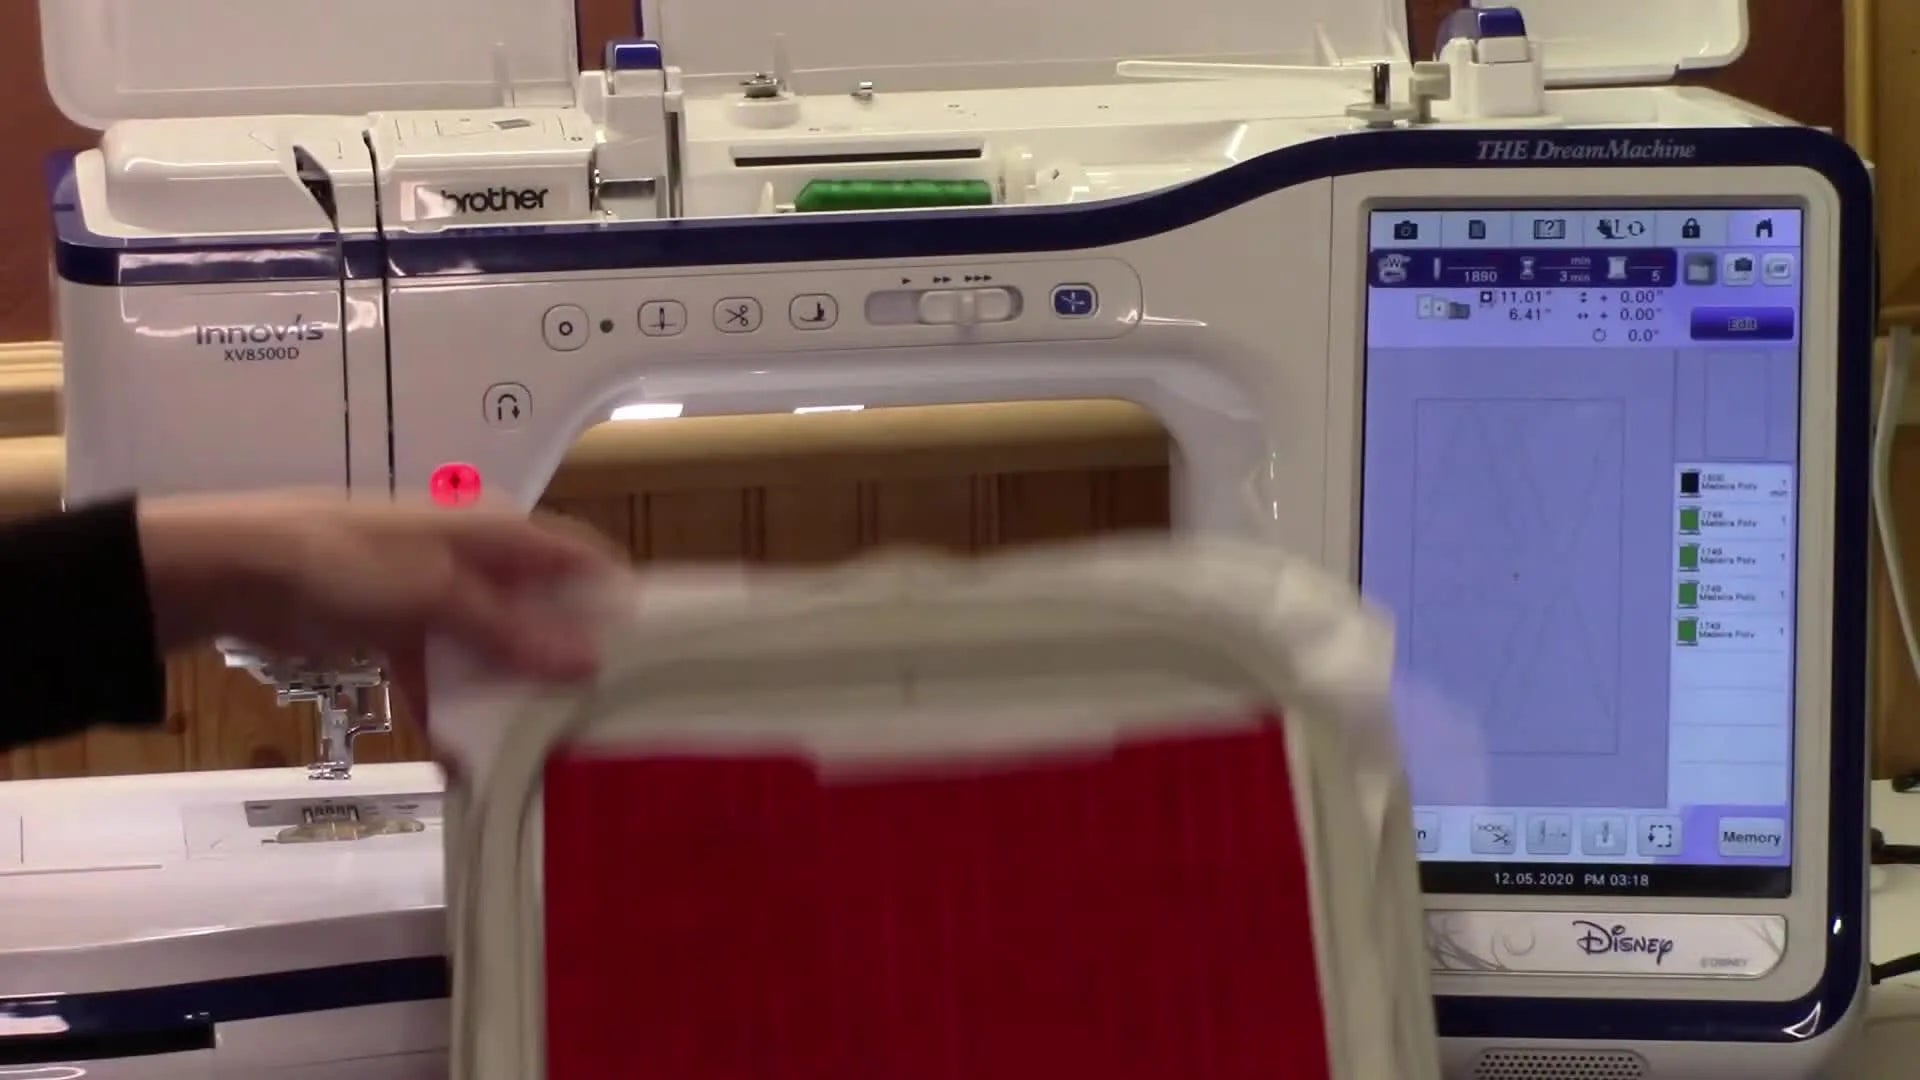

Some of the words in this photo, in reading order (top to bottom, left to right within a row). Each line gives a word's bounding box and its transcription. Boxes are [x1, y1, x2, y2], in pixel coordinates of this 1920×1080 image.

[1477, 139, 1528, 160] THE
[1533, 138, 1696, 160] DreamMachine
[1560, 271, 1567, 282] 3
[1652, 271, 1660, 283] 5
[224, 346, 299, 361] XV8500D
[1722, 831, 1782, 846] Memory
[1494, 872, 1574, 886] 12.05.2020
[1584, 874, 1606, 886] PM
[1609, 874, 1649, 887] 03:18
